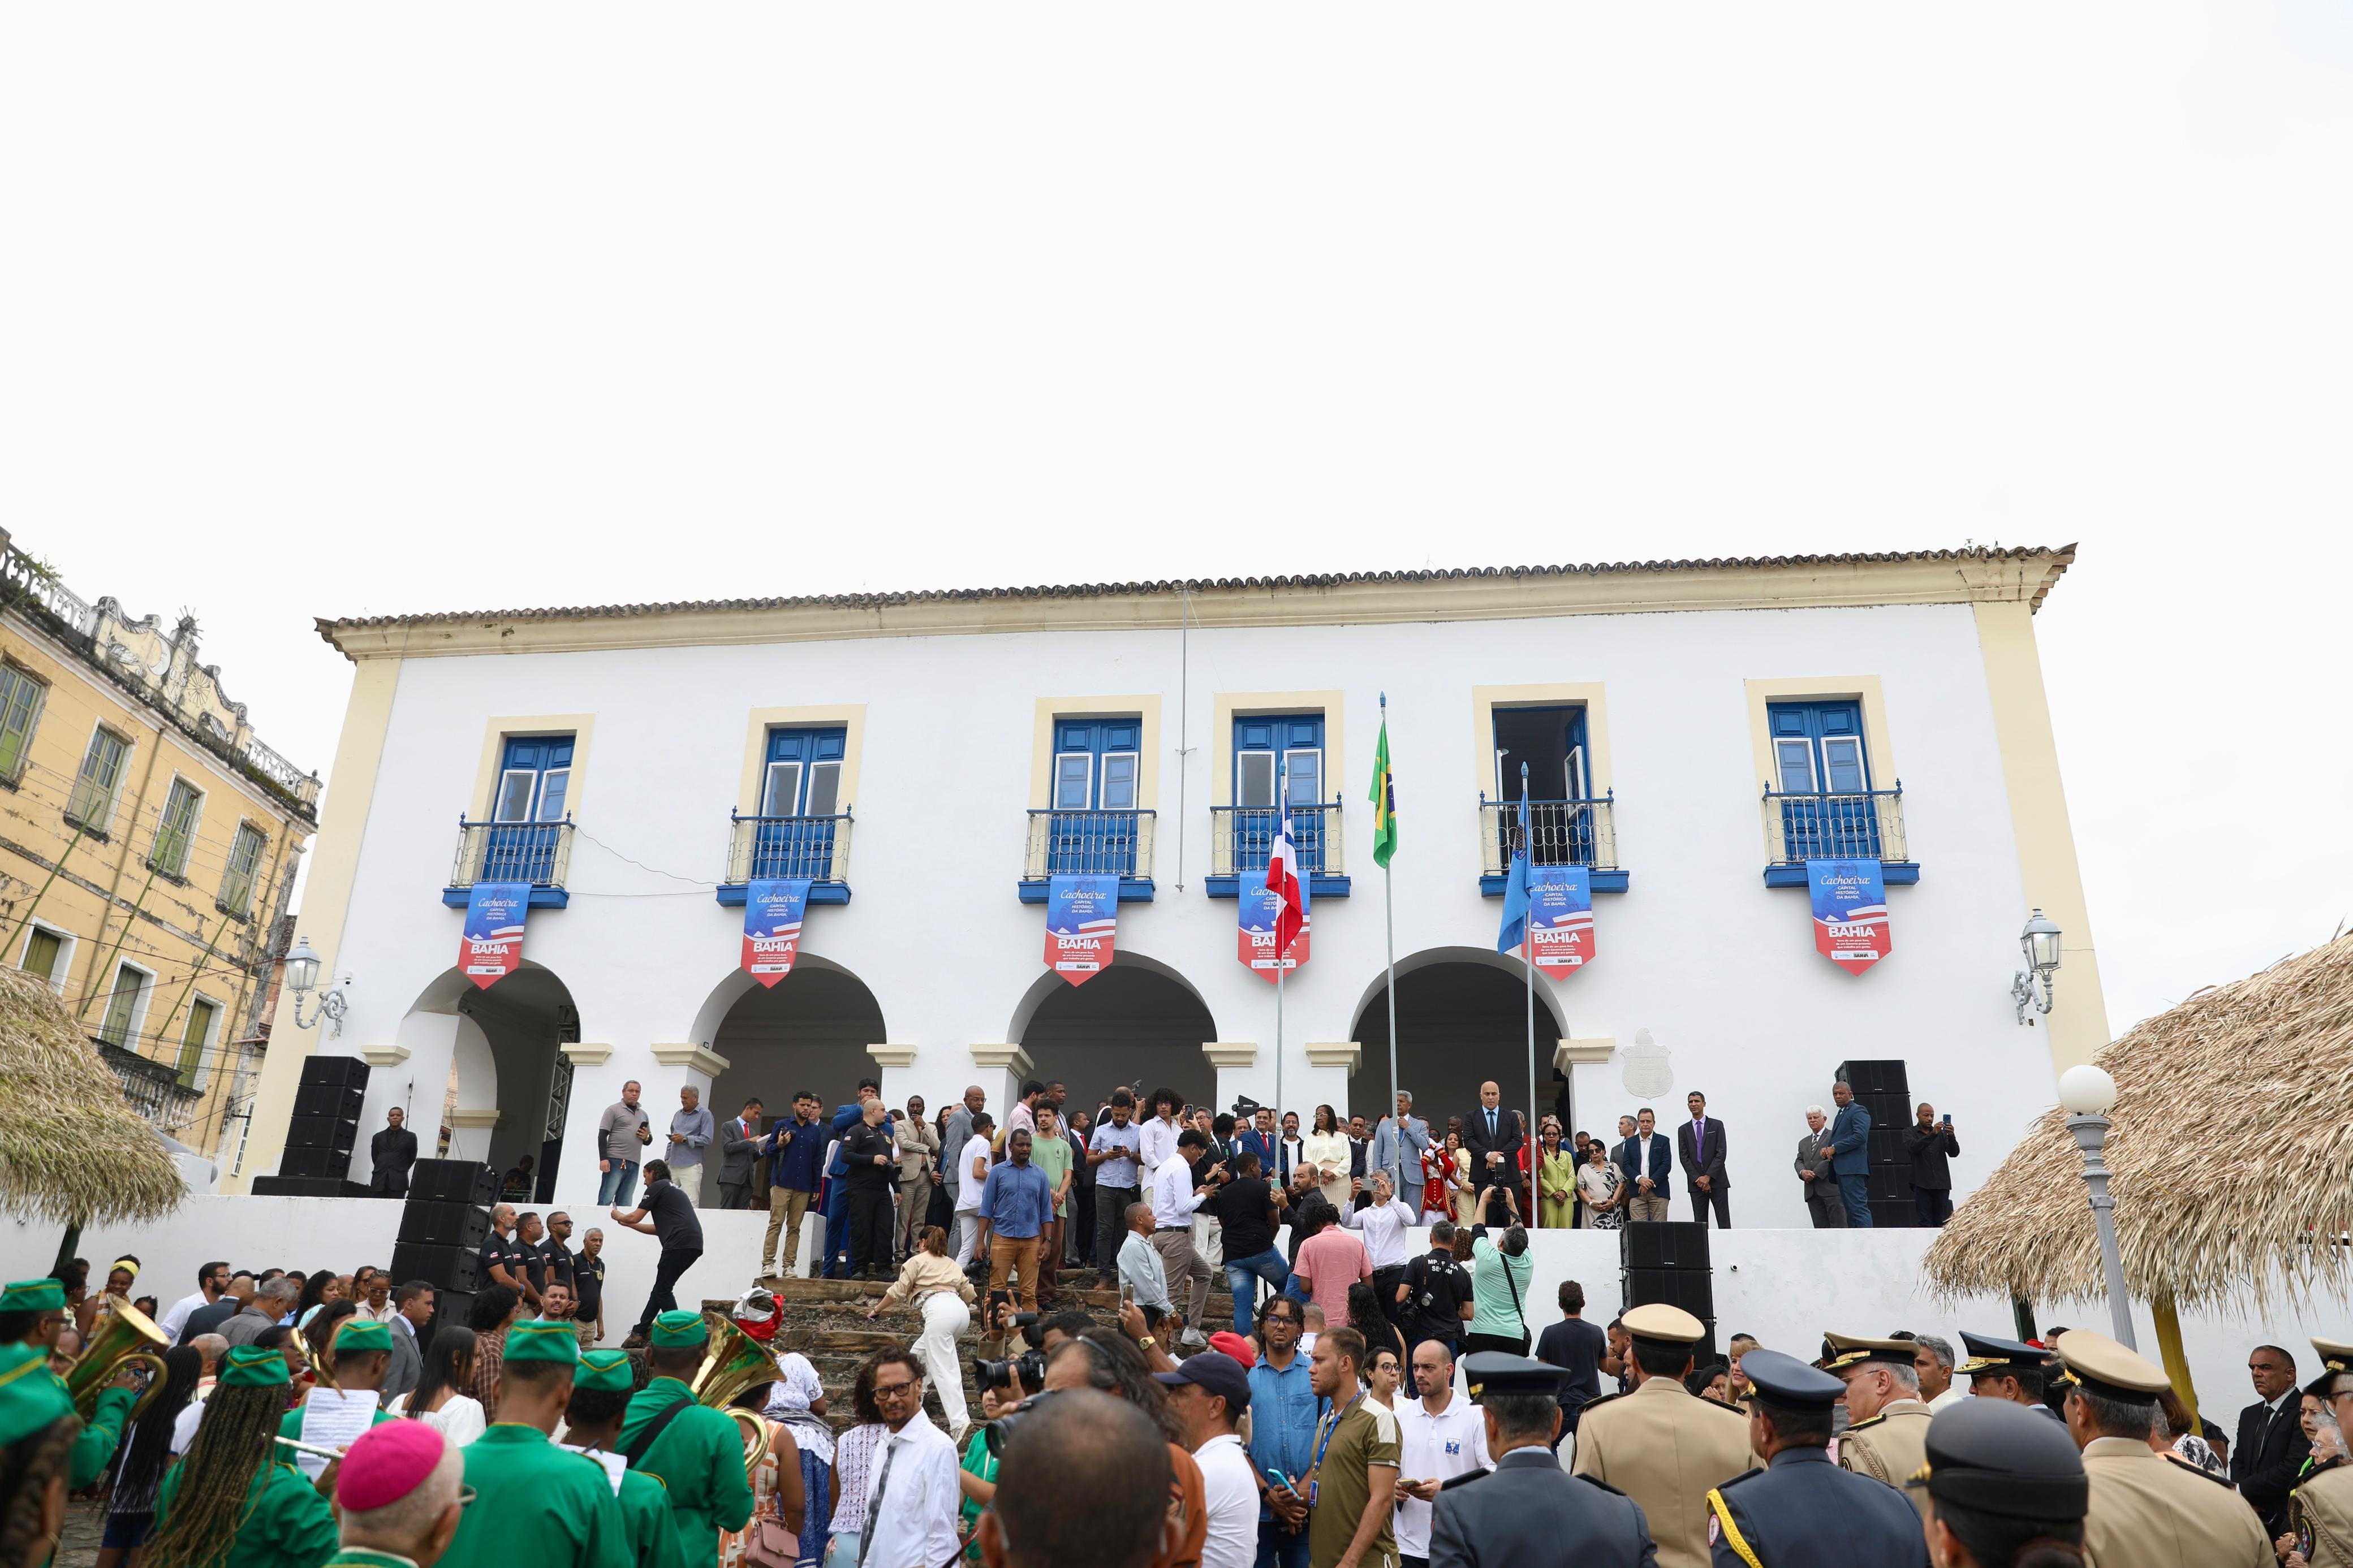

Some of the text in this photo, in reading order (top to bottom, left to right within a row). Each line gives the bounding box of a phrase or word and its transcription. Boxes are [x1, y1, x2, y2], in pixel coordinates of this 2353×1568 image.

[1821, 875, 1870, 885] Cachoeira:
[757, 893, 800, 903] Cachoeira:
[1061, 889, 1106, 900] Cachoeira:
[479, 897, 519, 907] Cachoeira:
[1829, 926, 1876, 938] BAHIA
[1534, 932, 1581, 944] BAHIA
[471, 944, 508, 954] BAHIA
[753, 942, 793, 952] BAHIA
[1058, 939, 1101, 949] BAHIA
[1428, 1259, 1458, 1271] MPESA
[1432, 1265, 1453, 1275] SEM
